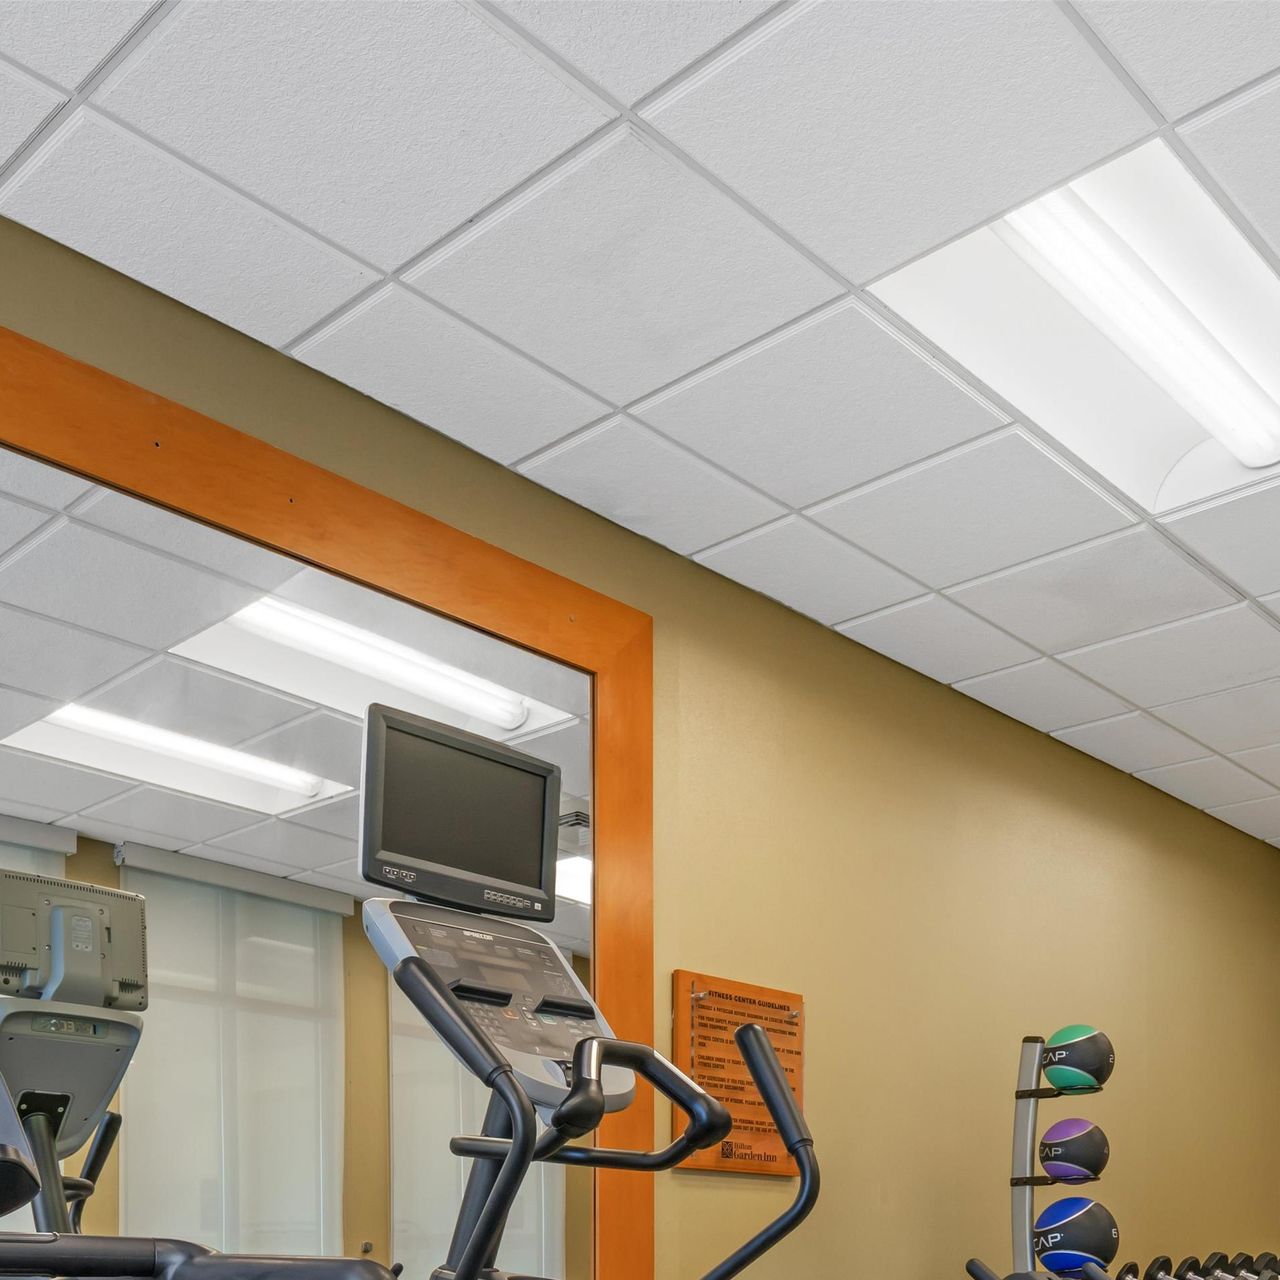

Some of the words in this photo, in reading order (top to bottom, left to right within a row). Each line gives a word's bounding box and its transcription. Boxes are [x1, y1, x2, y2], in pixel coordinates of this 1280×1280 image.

[709, 990, 732, 1000] FITNESS
[734, 996, 756, 1004] CENTER
[758, 1000, 790, 1011] GUIDELINES
[1042, 1051, 1066, 1064] CAP
[1109, 1054, 1114, 1064] 2
[734, 1142, 752, 1150] Hilton
[1040, 1147, 1062, 1157] CAP
[1112, 1228, 1118, 1238] 6
[1033, 1232, 1060, 1251] CAP
